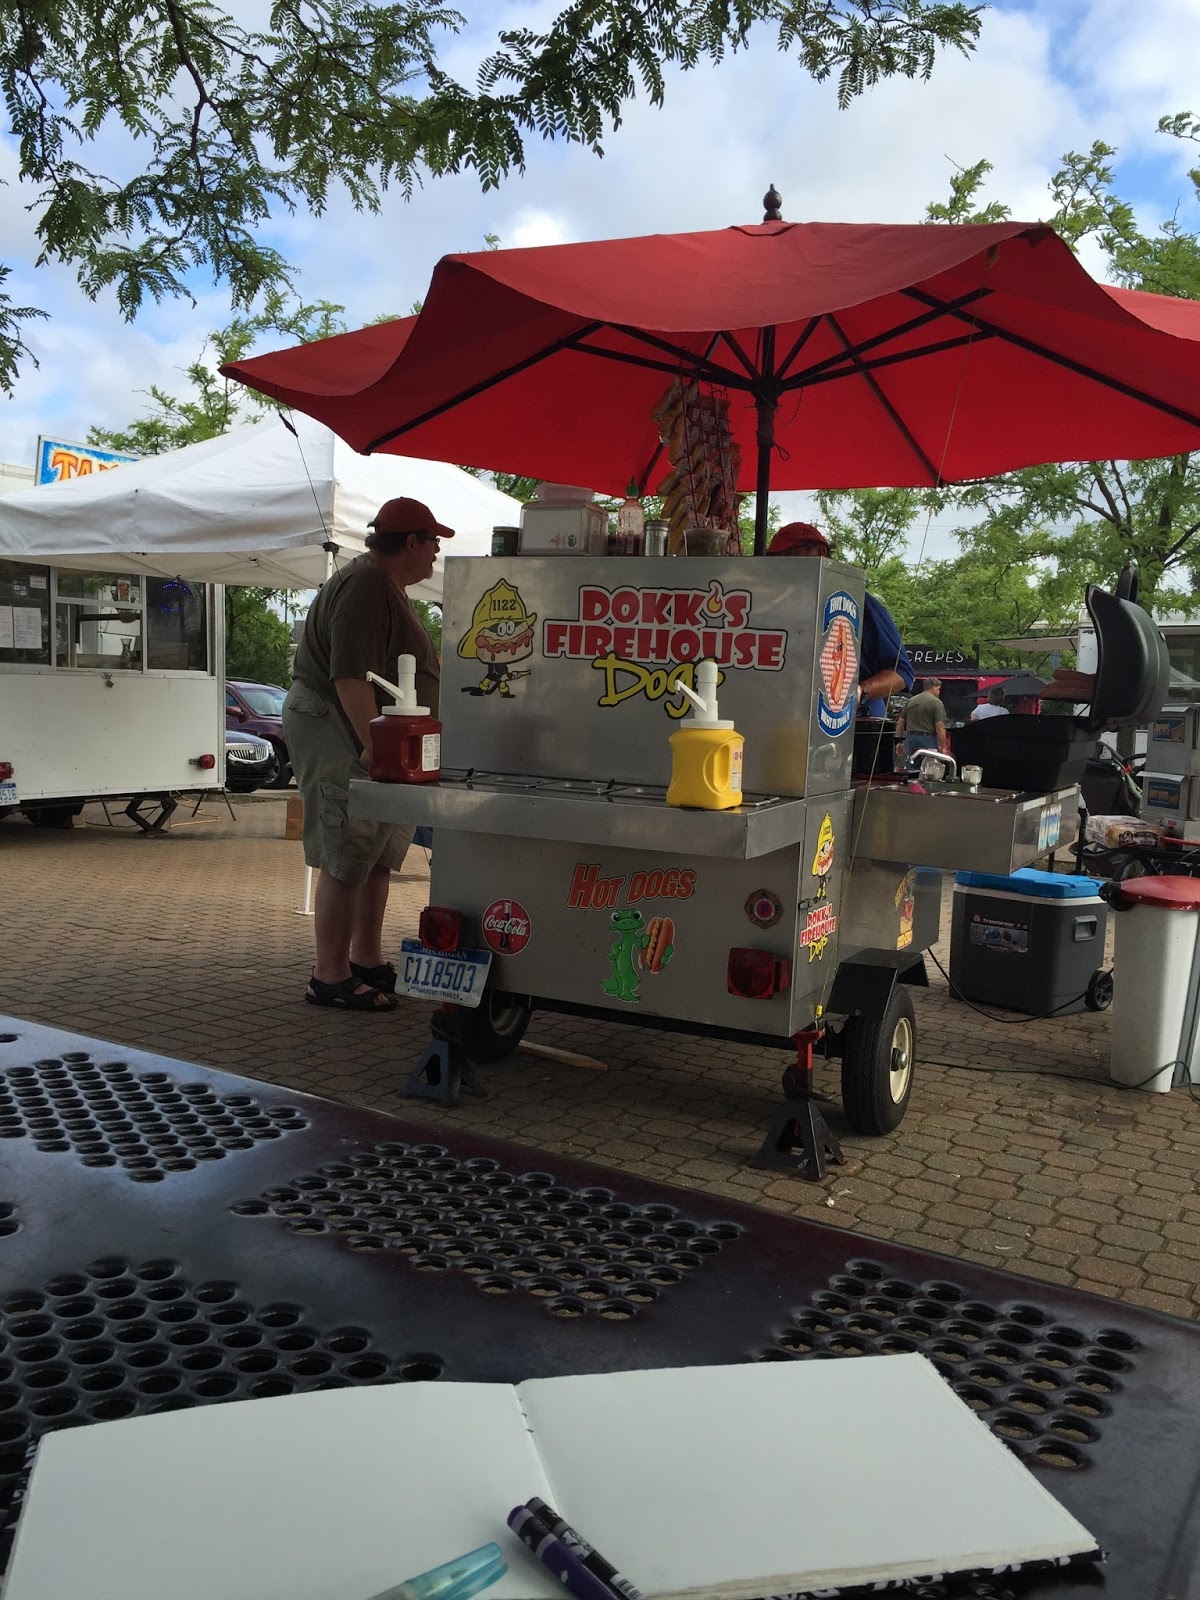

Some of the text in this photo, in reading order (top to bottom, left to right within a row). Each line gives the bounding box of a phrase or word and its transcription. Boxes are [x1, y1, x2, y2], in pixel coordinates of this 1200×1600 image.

[493, 599, 516, 611] 1122
[580, 581, 751, 629] DOKK'S
[829, 596, 857, 619] HOT DOGS
[544, 619, 787, 670] FIREHOUSE
[905, 650, 964, 663] CREPES
[592, 651, 725, 719] Dog
[626, 868, 697, 904] DOGS
[484, 914, 528, 936] Coca-Cola
[800, 916, 836, 947] FIREHOUSE
[404, 956, 477, 993] C118503
[411, 986, 460, 999] PERMANENT TRAILER
